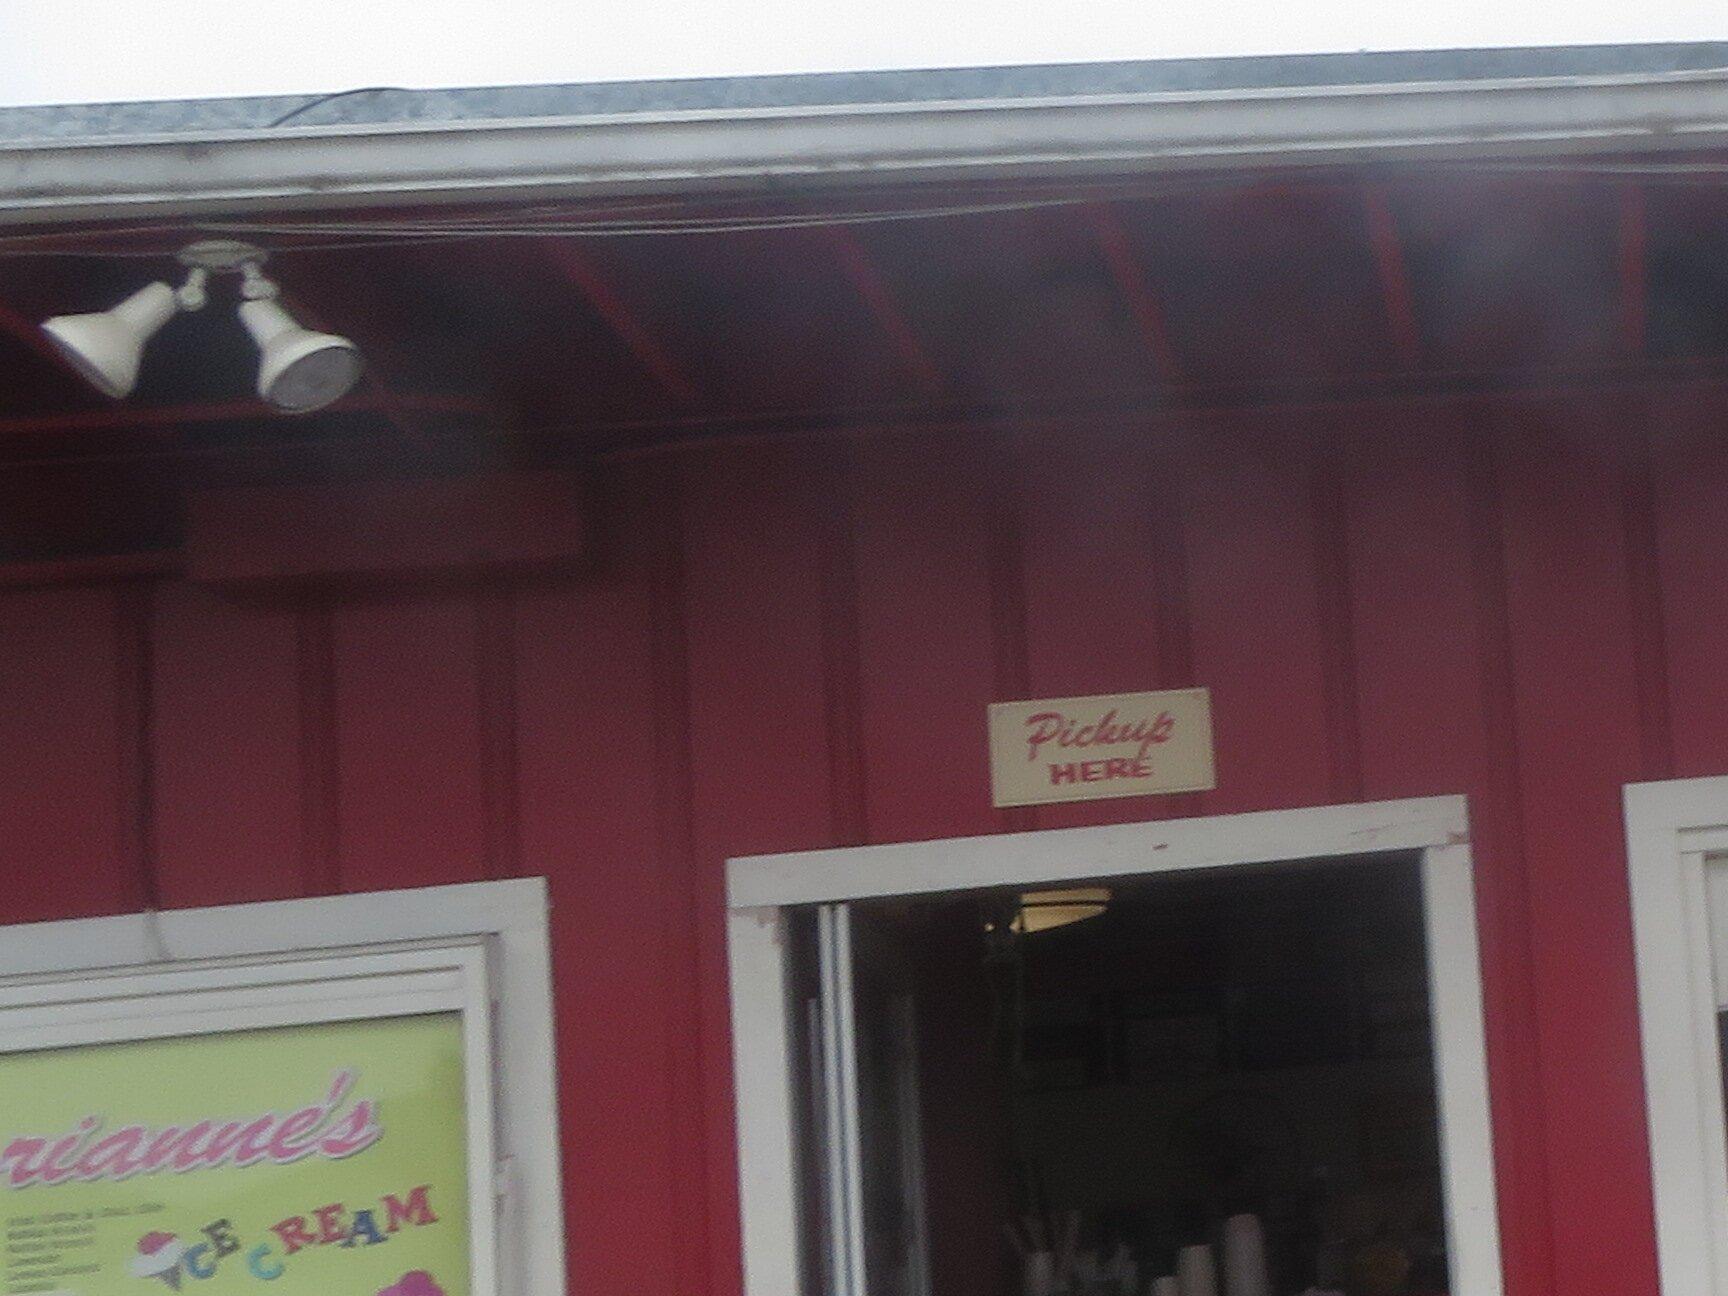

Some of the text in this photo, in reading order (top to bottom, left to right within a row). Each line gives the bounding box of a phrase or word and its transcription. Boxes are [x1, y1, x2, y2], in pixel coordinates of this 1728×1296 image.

[1024, 708, 1175, 761] Pickup
[1049, 756, 1155, 786] HERE
[247, 1183, 439, 1281] CREAM
